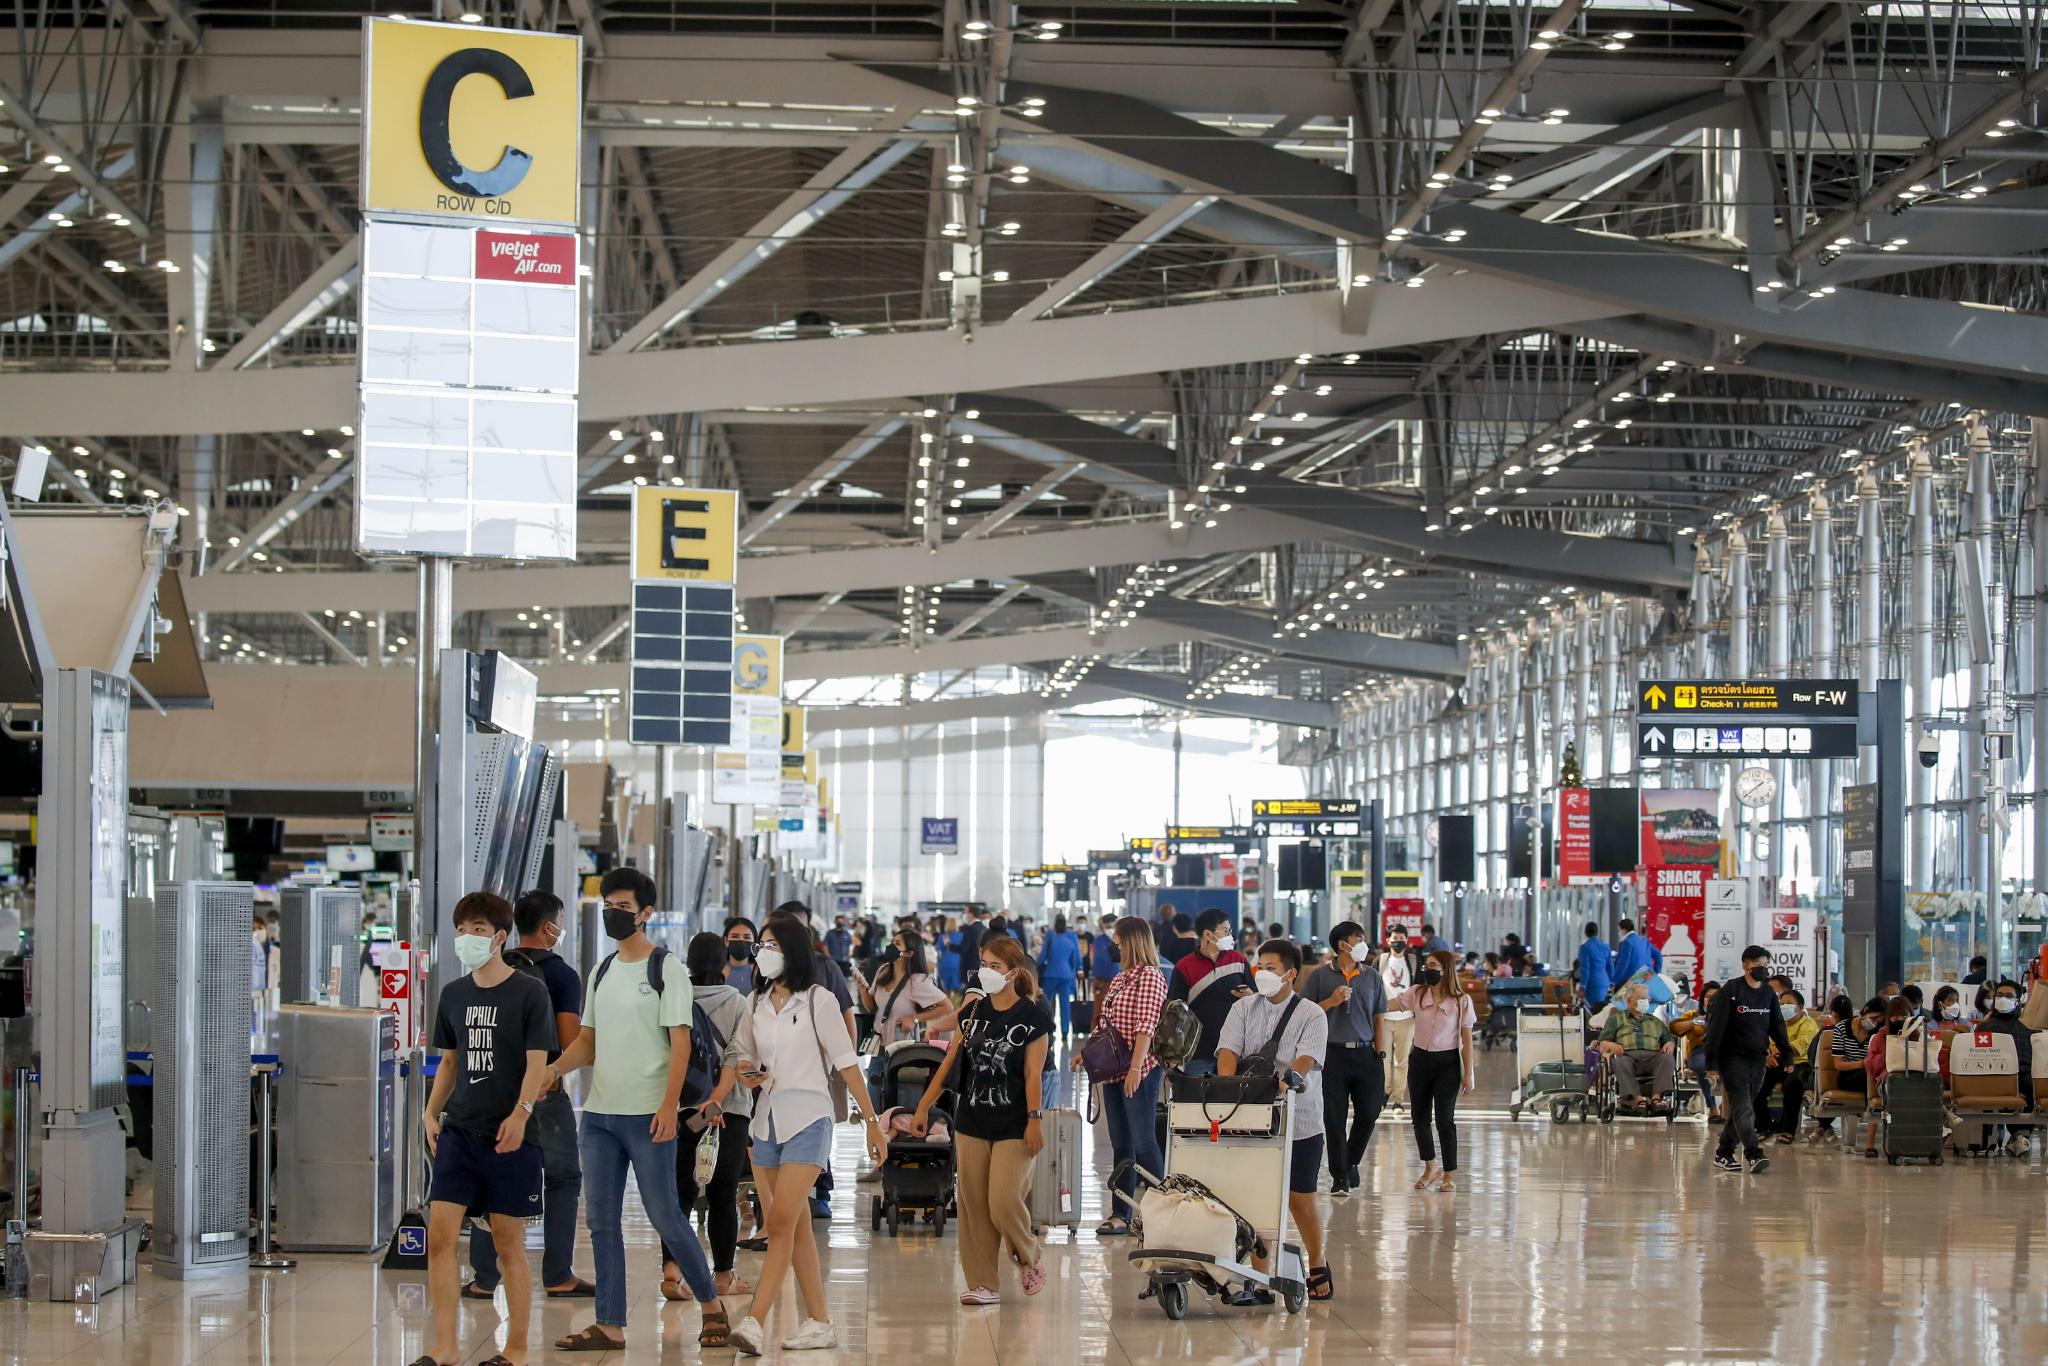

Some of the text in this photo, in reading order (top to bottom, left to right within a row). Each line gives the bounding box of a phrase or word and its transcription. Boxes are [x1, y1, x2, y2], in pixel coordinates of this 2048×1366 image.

[420, 48, 535, 198] C
[437, 195, 512, 215] ROW C/D
[661, 499, 709, 571] E
[734, 643, 769, 688] G
[1700, 700, 1733, 708] Check-in
[1793, 691, 1847, 705] Row F-W
[1722, 730, 1738, 739] VAT
[197, 789, 224, 799] E02
[369, 791, 396, 801] E01
[927, 823, 953, 835] VAT
[1657, 870, 1702, 884] SNACK
[1657, 885, 1702, 897] &DRINK
[1770, 953, 1803, 965] NOW
[1767, 966, 1806, 978] OPEN
[465, 1006, 498, 1027] UPHILL
[468, 1028, 493, 1049] BOTH
[467, 1050, 494, 1071] WAYS
